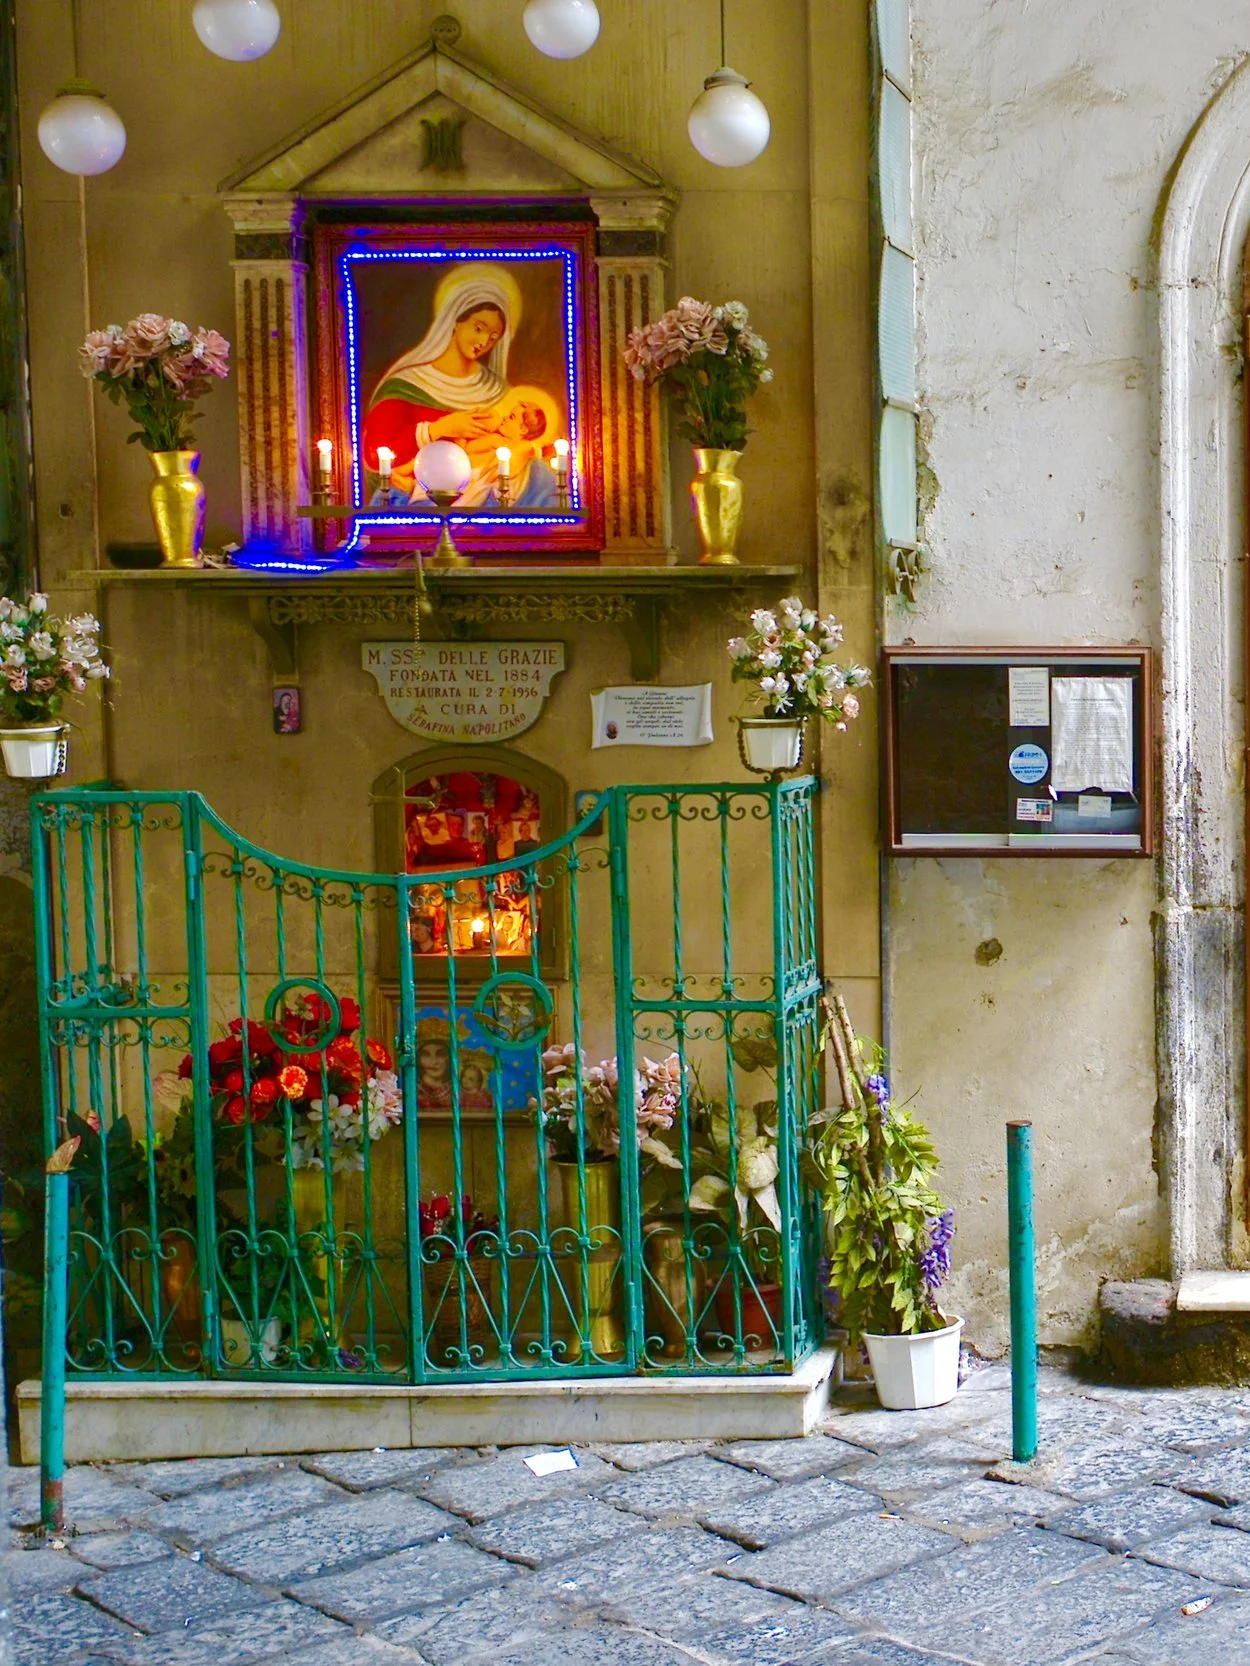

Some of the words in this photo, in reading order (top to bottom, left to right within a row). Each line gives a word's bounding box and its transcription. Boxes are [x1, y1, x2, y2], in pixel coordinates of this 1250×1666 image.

[439, 650, 488, 665] DELLE
[498, 649, 557, 665] GRAZIE
[390, 669, 457, 682] FONDATA
[465, 670, 494, 682] NEL
[504, 669, 541, 682] 1884
[390, 687, 461, 697] RESTAURATA
[469, 687, 479, 697] IL
[415, 704, 428, 715] A
[440, 703, 488, 715] CURA
[499, 704, 515, 715] DI
[406, 713, 455, 735] SERAFINA
[462, 712, 526, 736] NAPOLITANO
